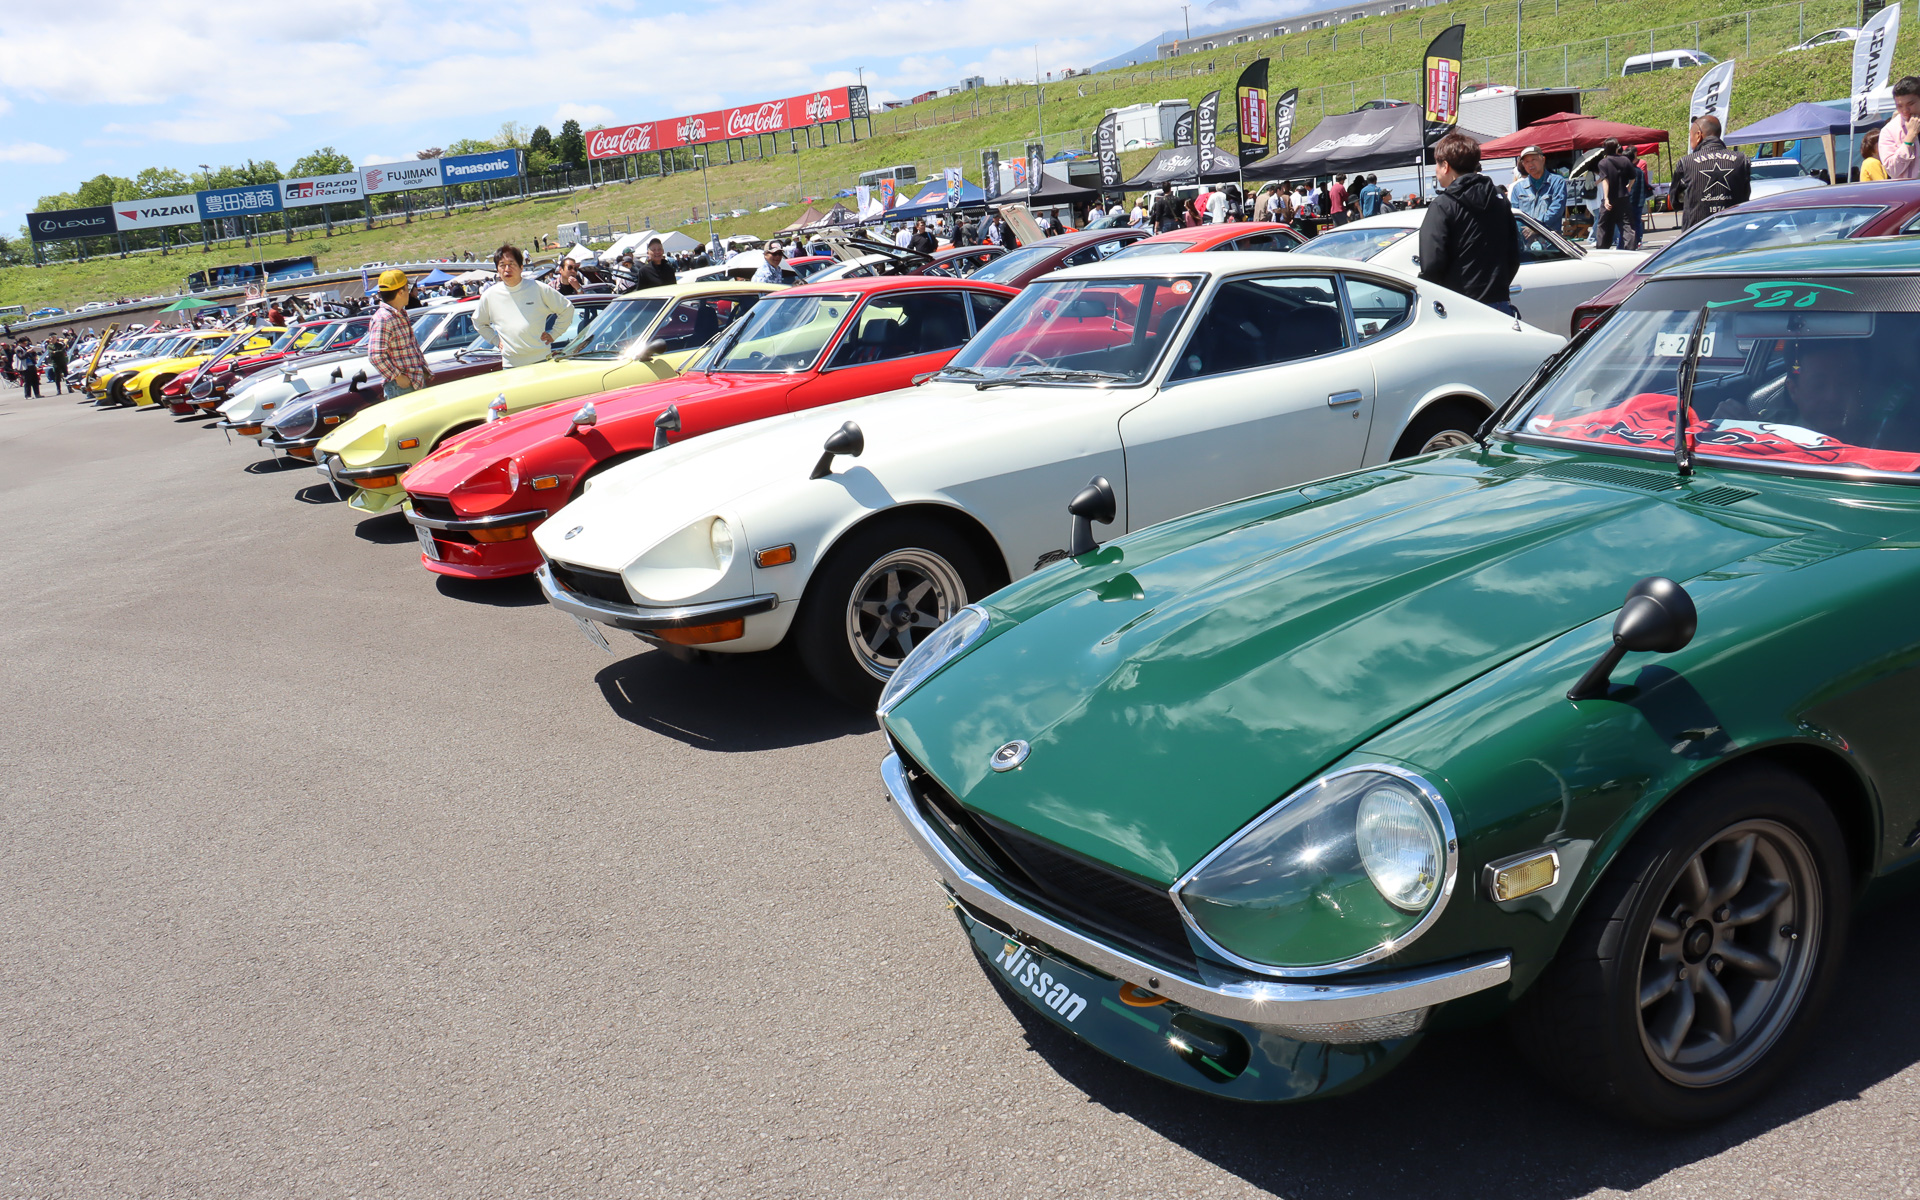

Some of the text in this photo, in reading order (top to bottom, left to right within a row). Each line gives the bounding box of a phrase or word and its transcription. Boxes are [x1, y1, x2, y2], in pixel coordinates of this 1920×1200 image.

[1438, 61, 1450, 121] ESCORT
[727, 101, 785, 136] Coca-Cola
[1249, 89, 1261, 142] ESCORT
[1278, 93, 1295, 153] VeilSid
[590, 124, 653, 157] Coca-Cola
[1177, 115, 1192, 146] Veil
[1199, 95, 1217, 172] VeilSide
[1099, 118, 1117, 185] VeilSide
[1157, 155, 1192, 170] VeSide
[1693, 152, 1738, 164] VANSON
[387, 166, 438, 181] FUJIMAKI
[446, 158, 510, 177] Panasonic
[315, 179, 358, 189] GAZOO
[316, 186, 357, 196] Racing
[140, 204, 195, 218] YAZAKI
[205, 189, 275, 213] 豊田通商
[57, 216, 106, 229] LEXUS
[995, 945, 1087, 1023] Nissan
